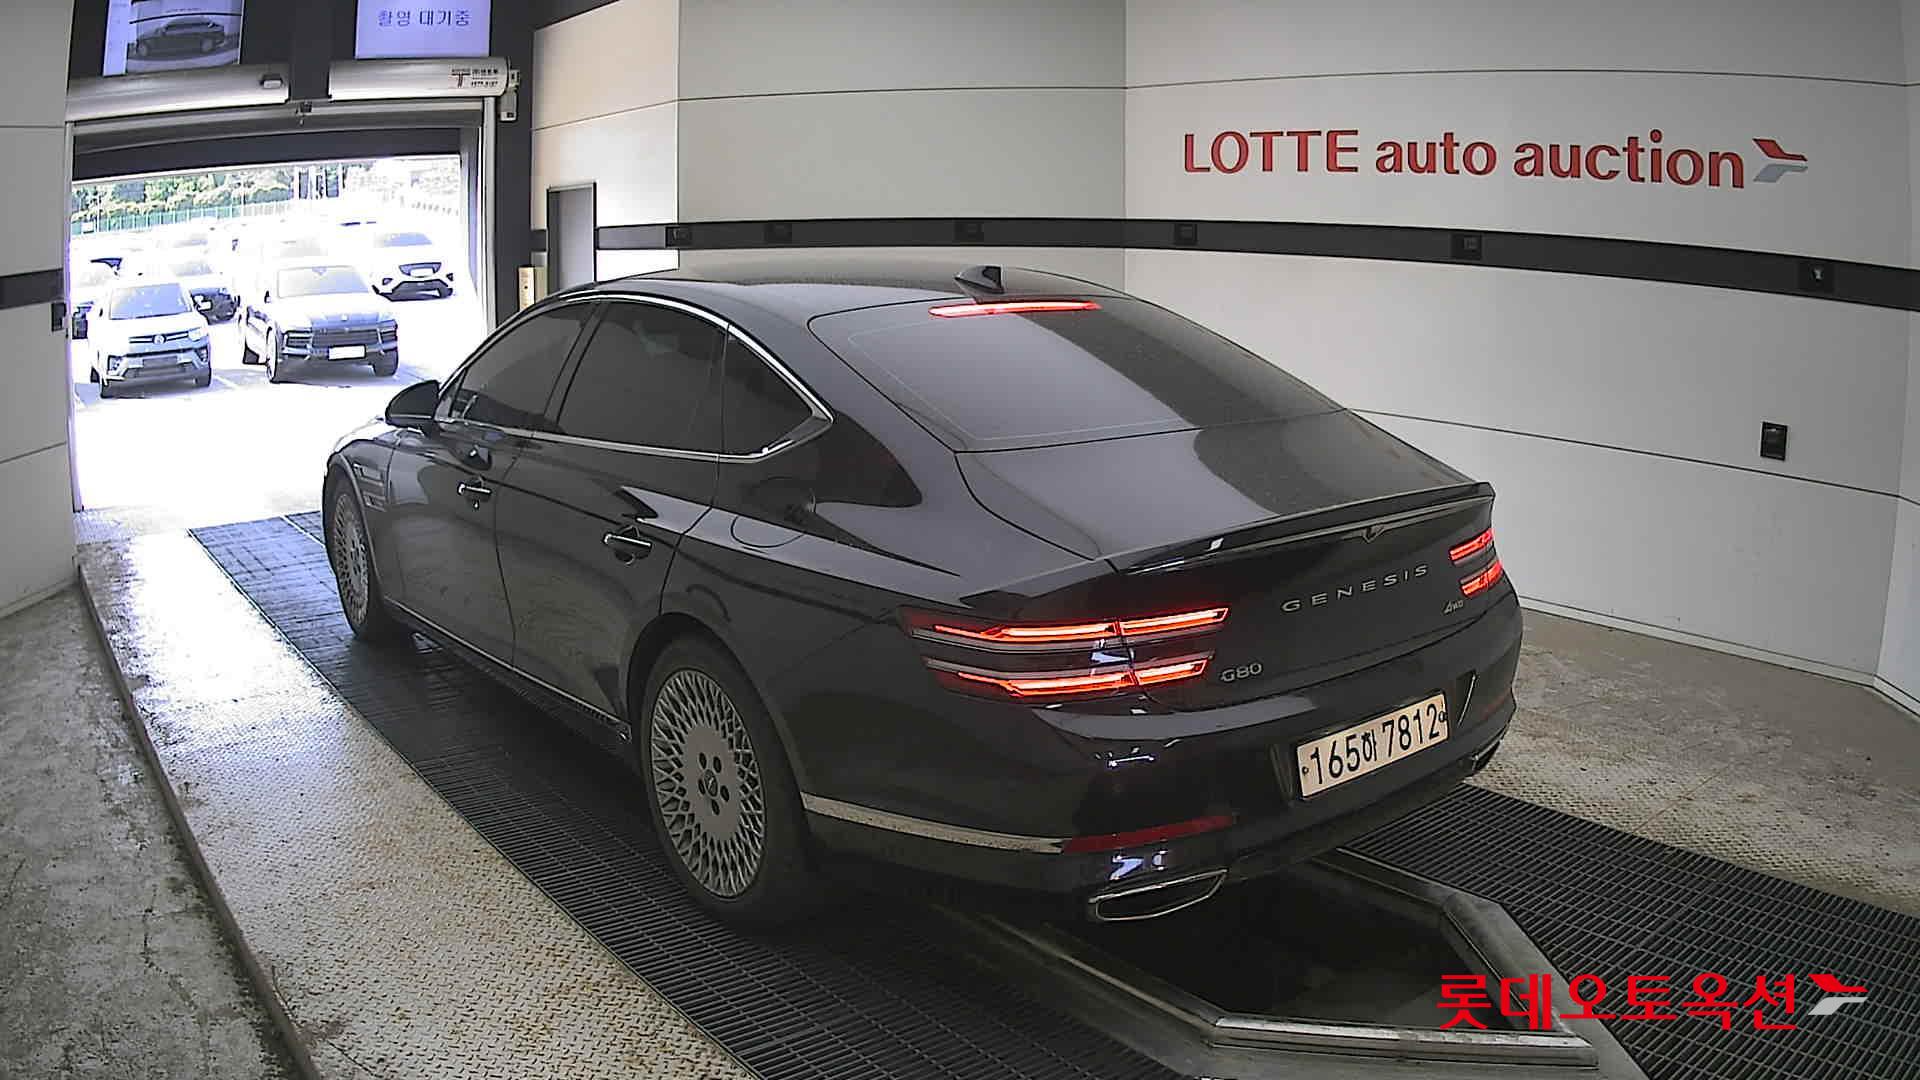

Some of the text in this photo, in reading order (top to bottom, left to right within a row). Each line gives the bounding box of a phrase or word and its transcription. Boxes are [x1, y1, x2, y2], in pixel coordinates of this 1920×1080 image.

[419, 9, 470, 27] 대기중
[1184, 129, 1745, 189] LOTTE auto auction
[1281, 563, 1429, 613] GENESIS
[1220, 662, 1263, 683] G80
